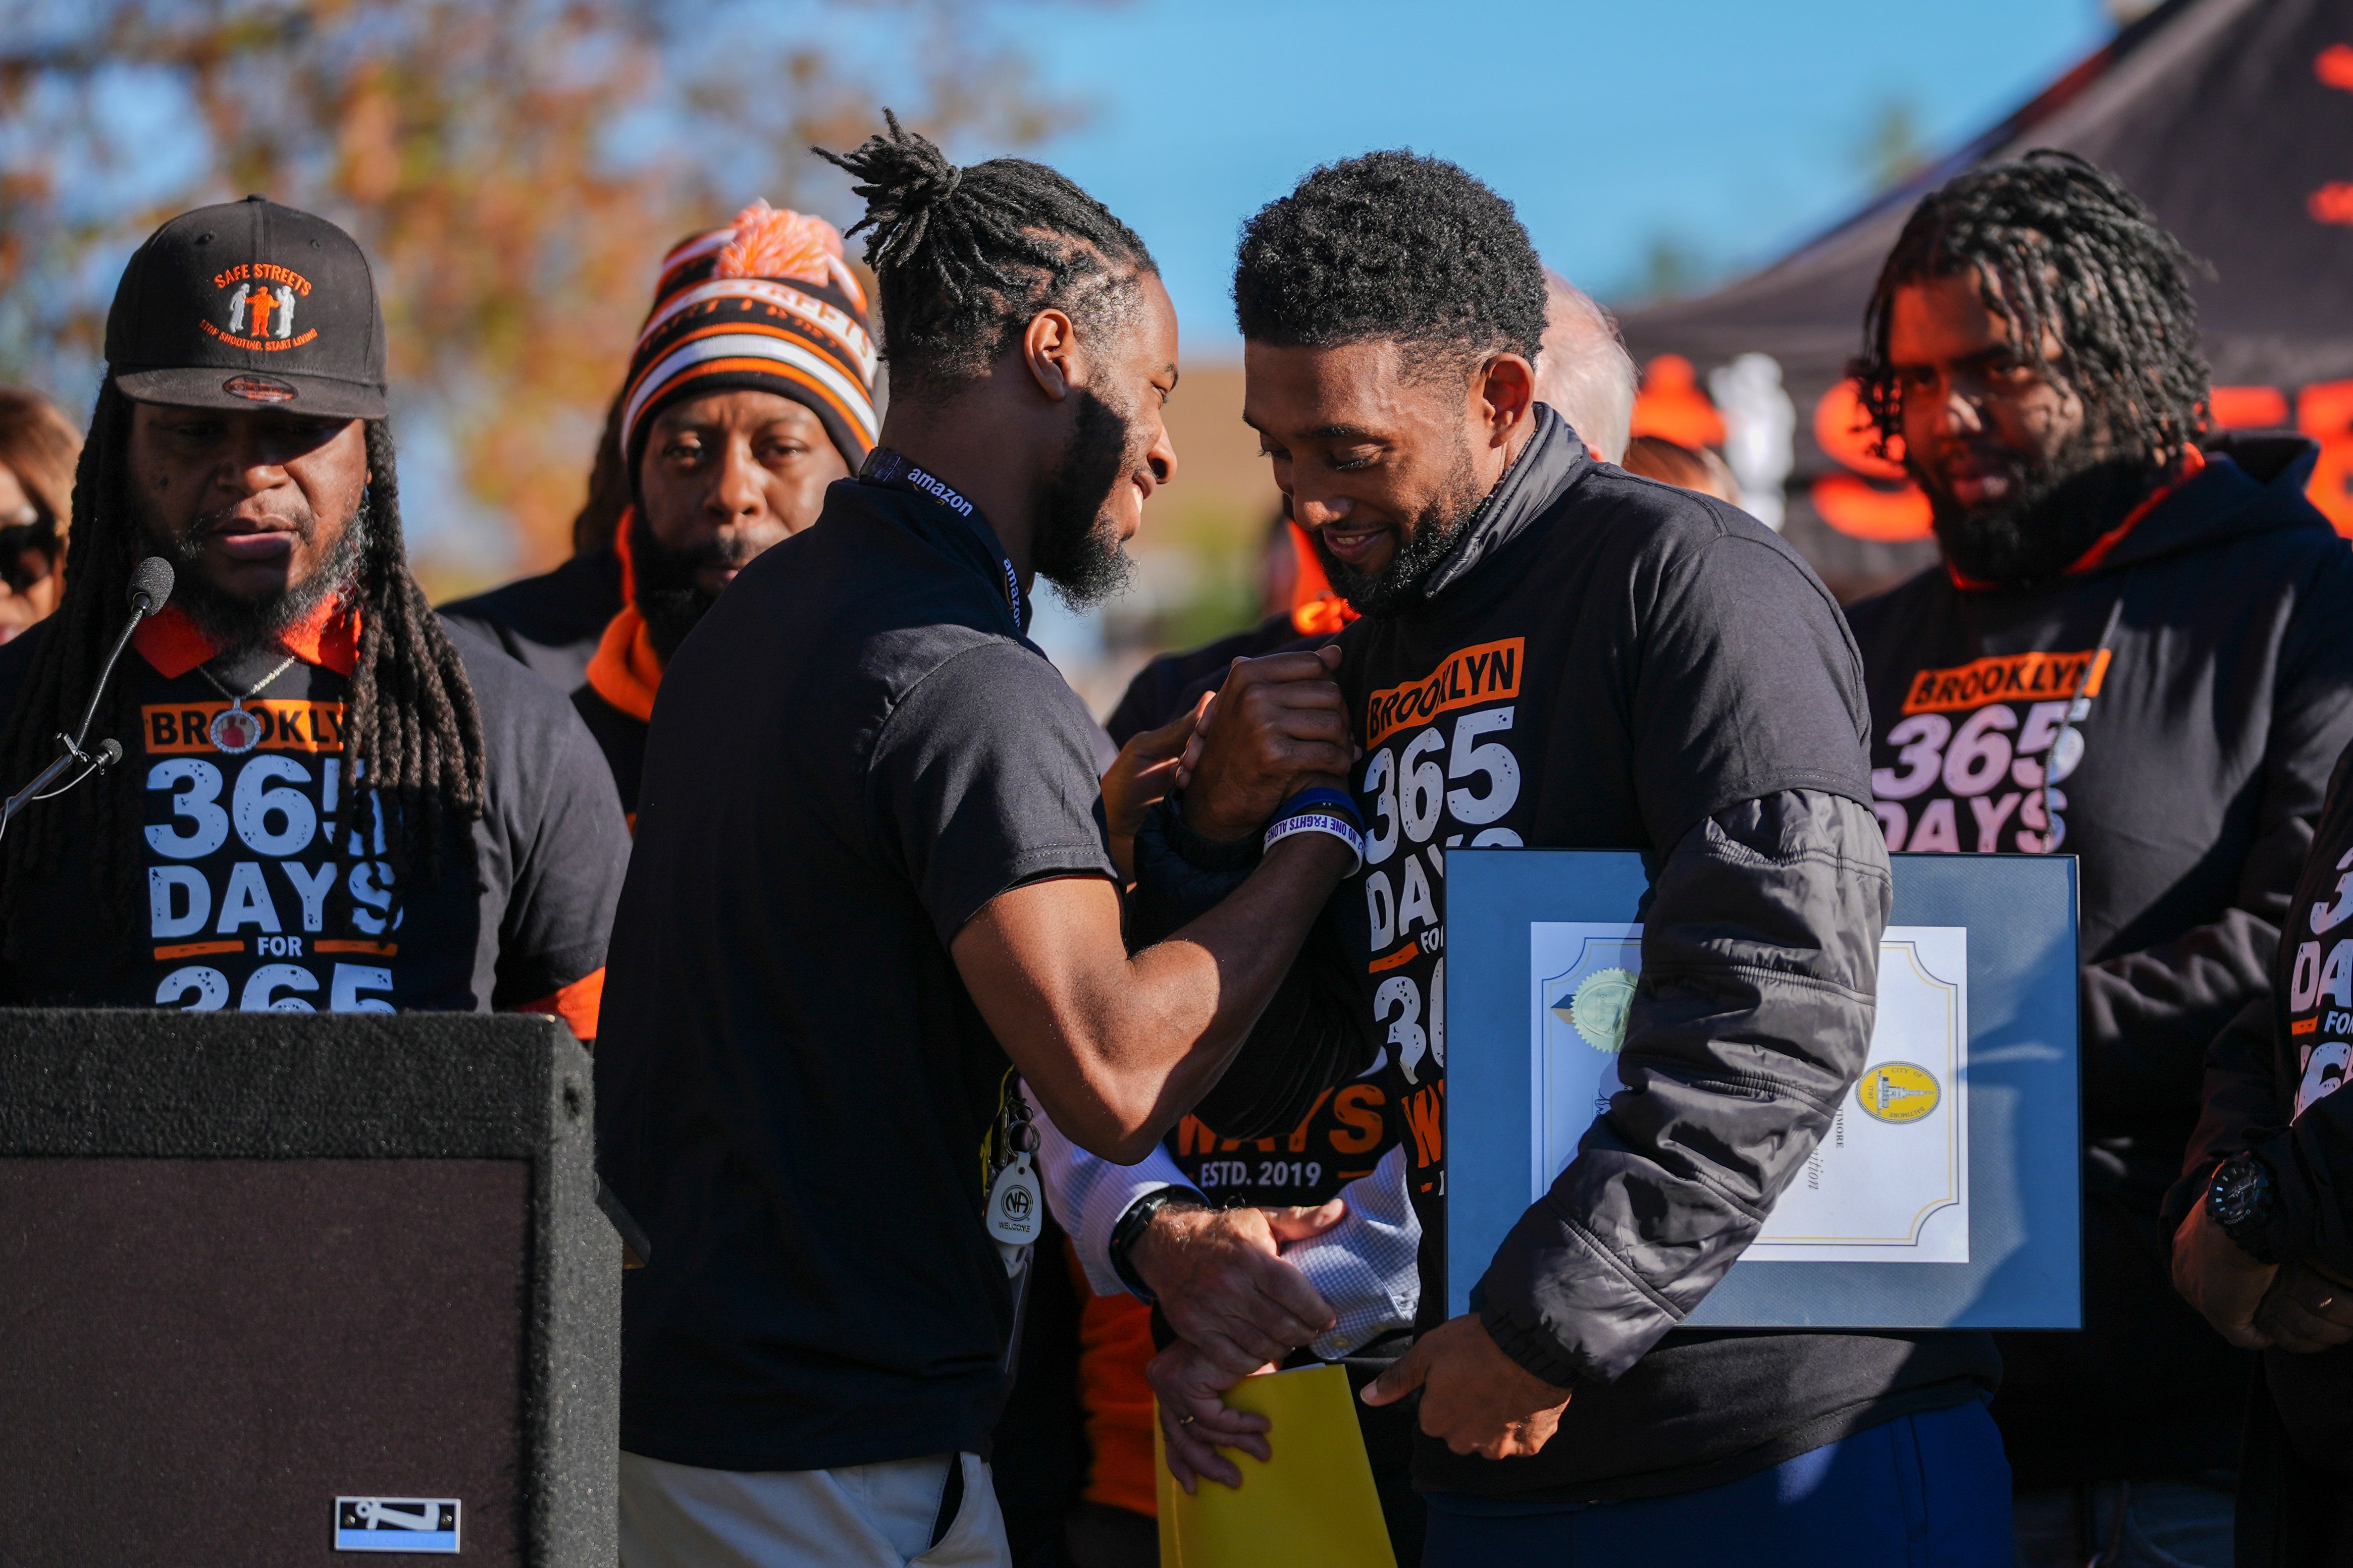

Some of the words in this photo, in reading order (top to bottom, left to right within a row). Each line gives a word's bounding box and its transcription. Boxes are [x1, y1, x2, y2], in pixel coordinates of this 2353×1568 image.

[214, 263, 250, 289] SAFE
[253, 263, 311, 297] STREETS
[199, 319, 220, 336] STOP
[265, 338, 291, 351] START
[292, 328, 318, 347] LIVING
[908, 467, 973, 517] amazon
[1004, 558, 1021, 628] amazon
[1370, 647, 1515, 739] BROOKLYN
[152, 708, 348, 745] BROKLY
[1871, 698, 2091, 800] 365
[1364, 706, 1521, 864] 365
[1267, 821, 1288, 843] ALONE
[1289, 816, 1328, 831] FGHTS
[1330, 818, 1346, 836] ONE
[1348, 828, 1357, 844] NO
[149, 861, 404, 938] DAYS
[258, 936, 303, 957] FOR
[1421, 925, 1444, 954] FO
[2291, 939, 2352, 1012] DA
[1890, 1107, 1925, 1118] BALTIMORE
[1200, 1162, 1252, 1188] ESTD.
[1259, 1162, 1322, 1187] 2019
[1006, 1191, 1029, 1213] NA
[999, 1222, 1030, 1232] WELCOME
